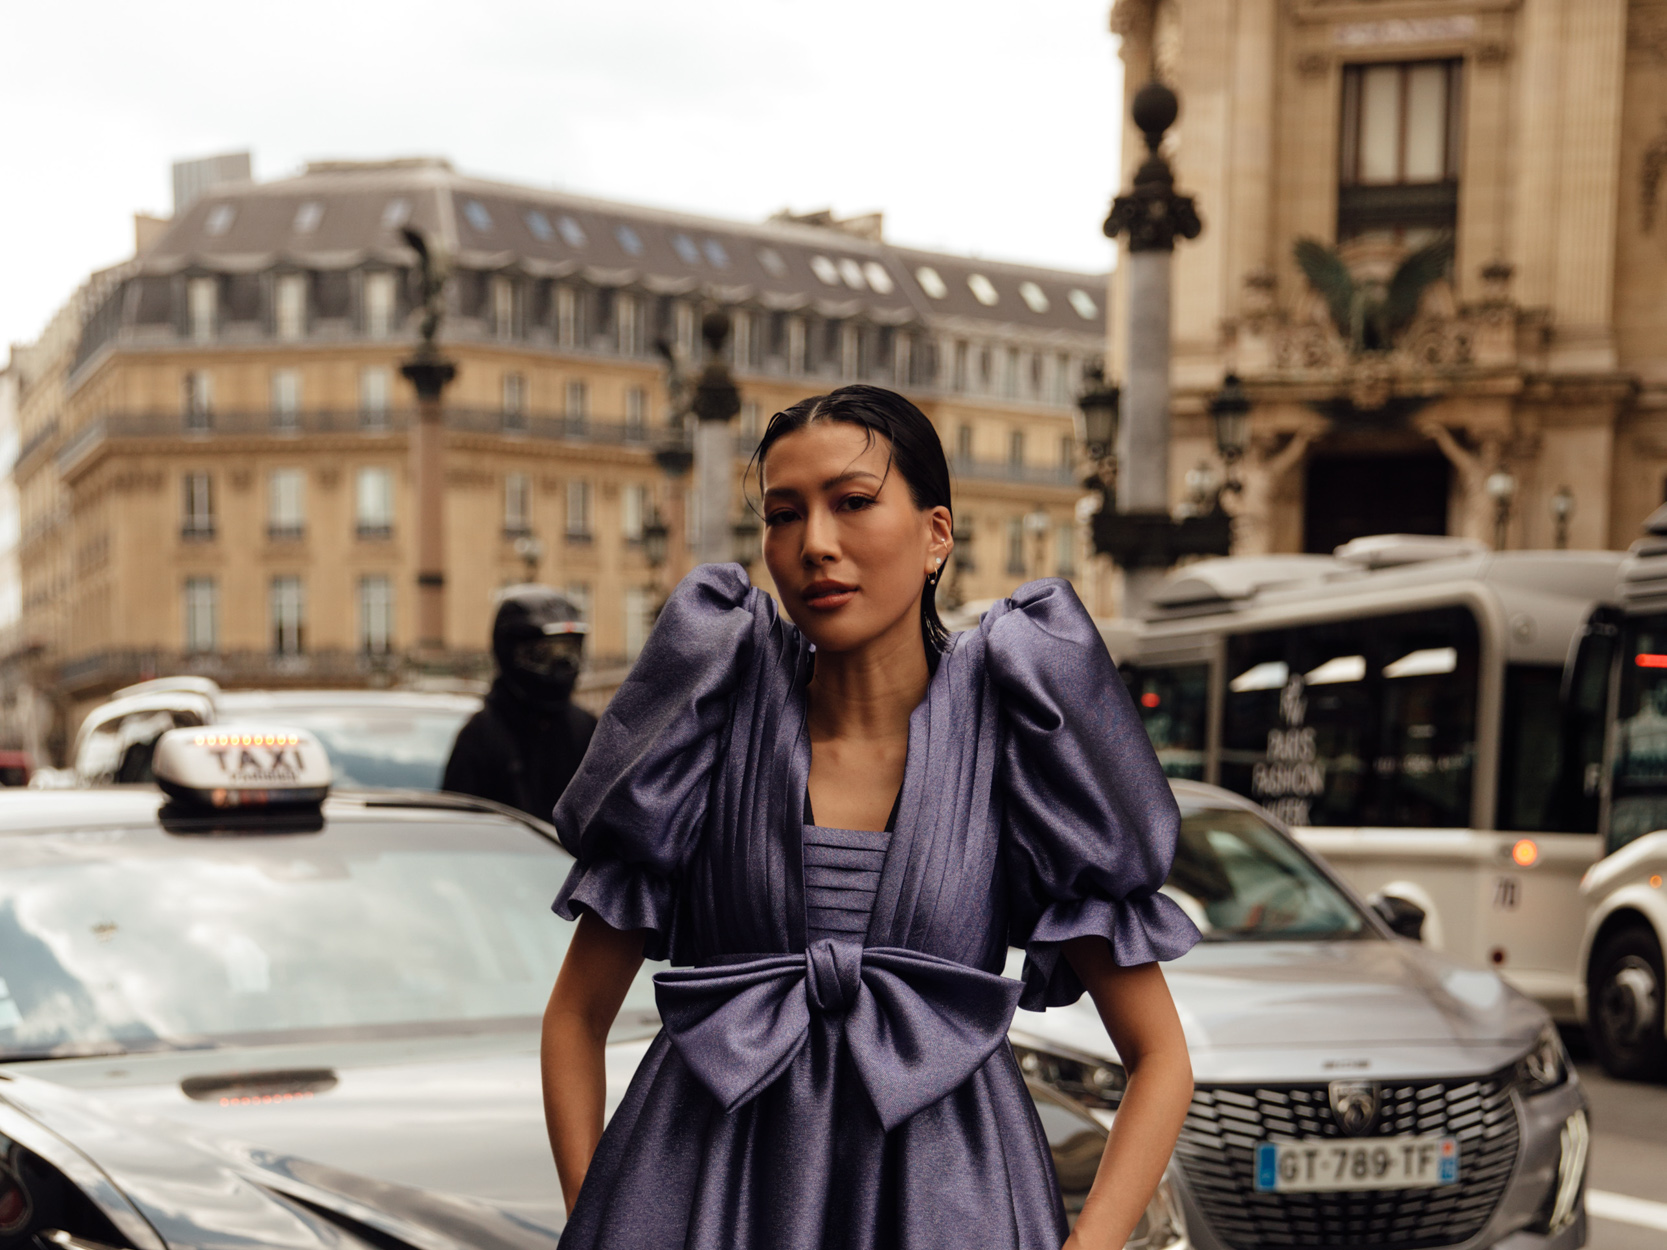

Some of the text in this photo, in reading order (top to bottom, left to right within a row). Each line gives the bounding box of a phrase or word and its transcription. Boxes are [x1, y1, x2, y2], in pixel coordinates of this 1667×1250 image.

[208, 747, 305, 772] TAXI
[1267, 728, 1317, 763] PARIS
[1252, 761, 1326, 797] FASHION
